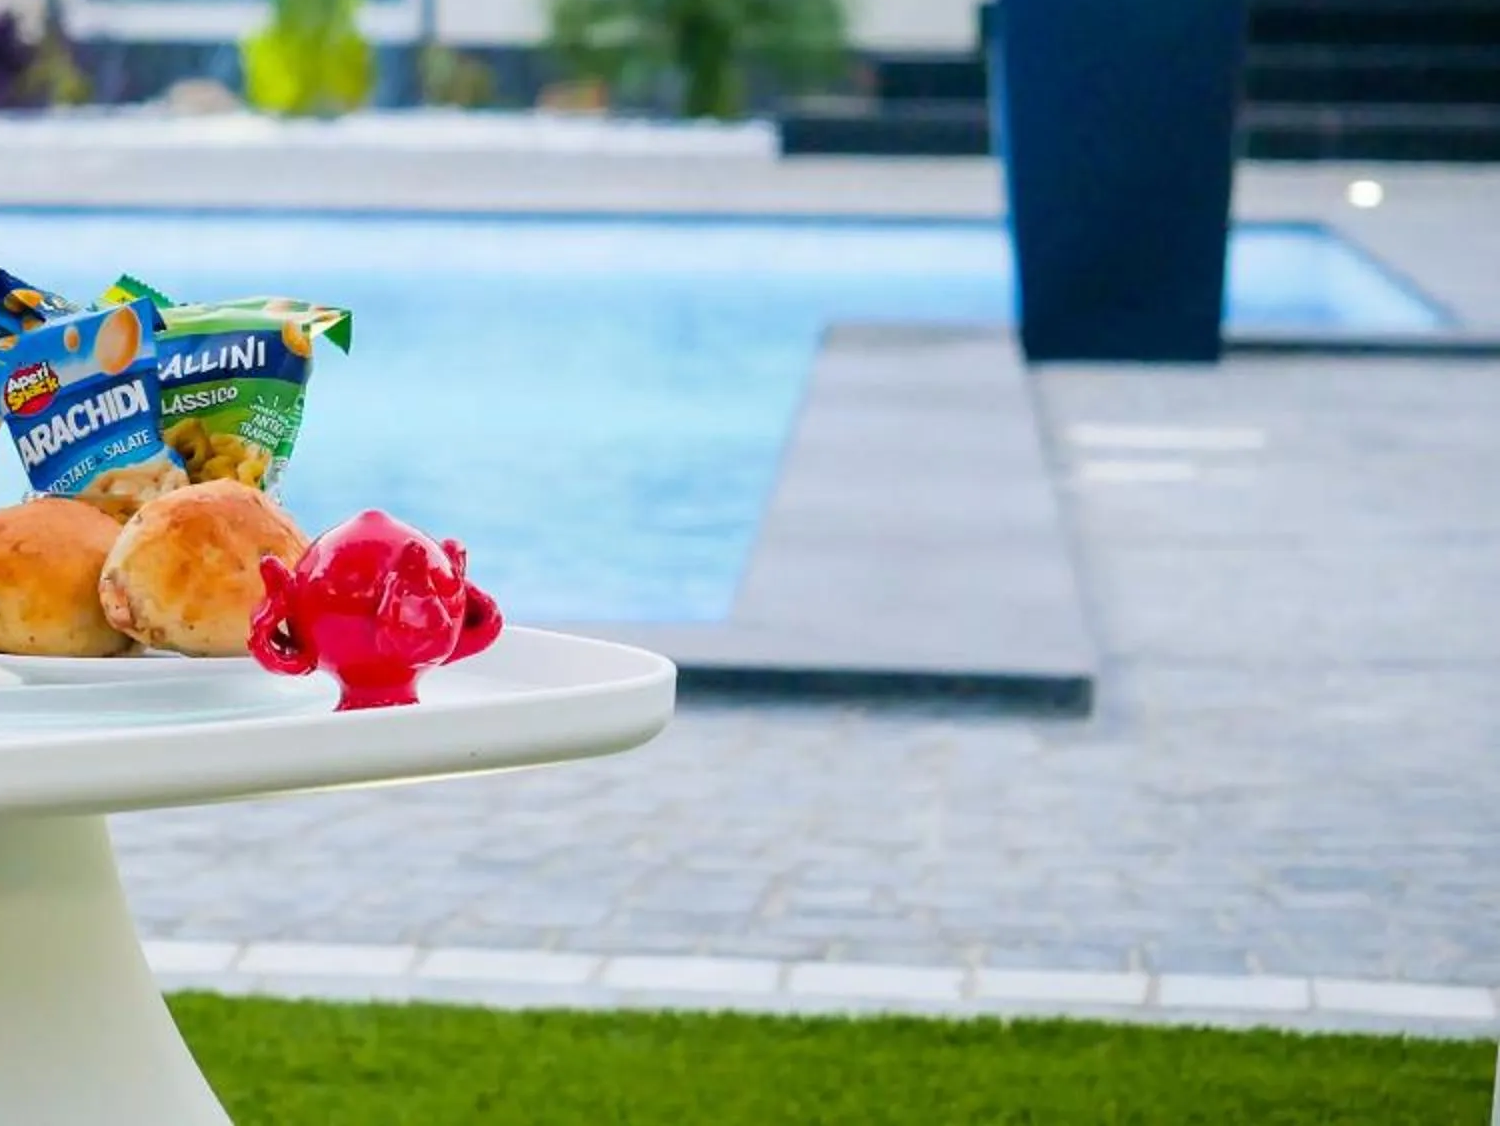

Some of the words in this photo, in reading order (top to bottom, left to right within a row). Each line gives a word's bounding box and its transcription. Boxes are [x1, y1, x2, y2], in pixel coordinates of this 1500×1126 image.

[158, 335, 266, 381] ALLINI
[161, 385, 239, 415] LASSICO
[16, 379, 151, 472] ARACHIDI
[102, 428, 153, 460] SALATE
